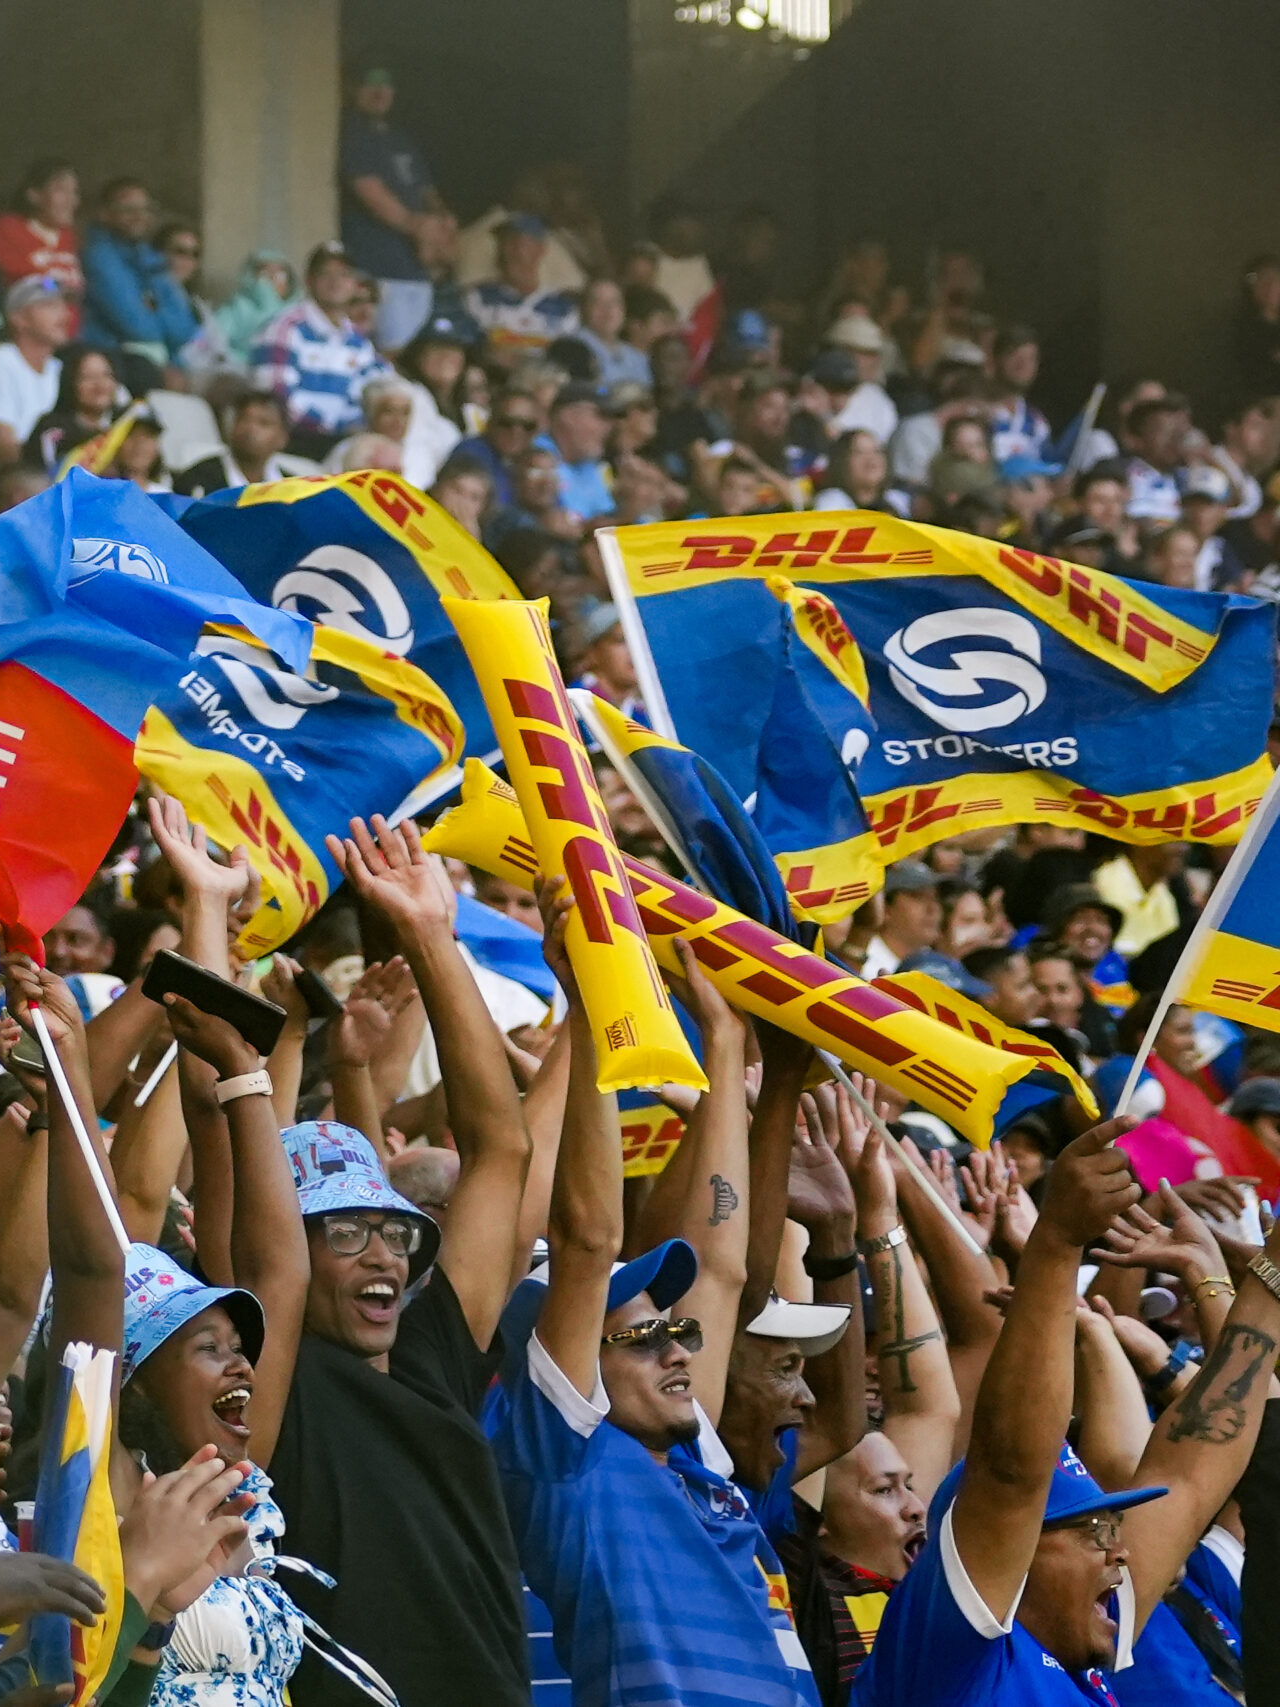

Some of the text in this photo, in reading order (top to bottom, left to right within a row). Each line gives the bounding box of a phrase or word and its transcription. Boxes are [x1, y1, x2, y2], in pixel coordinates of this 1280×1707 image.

[681, 526, 894, 570] DHL
[882, 736, 1079, 768] STORERS
[503, 655, 644, 945] DHL
[867, 786, 961, 848] HL
[621, 1117, 682, 1161] DH
